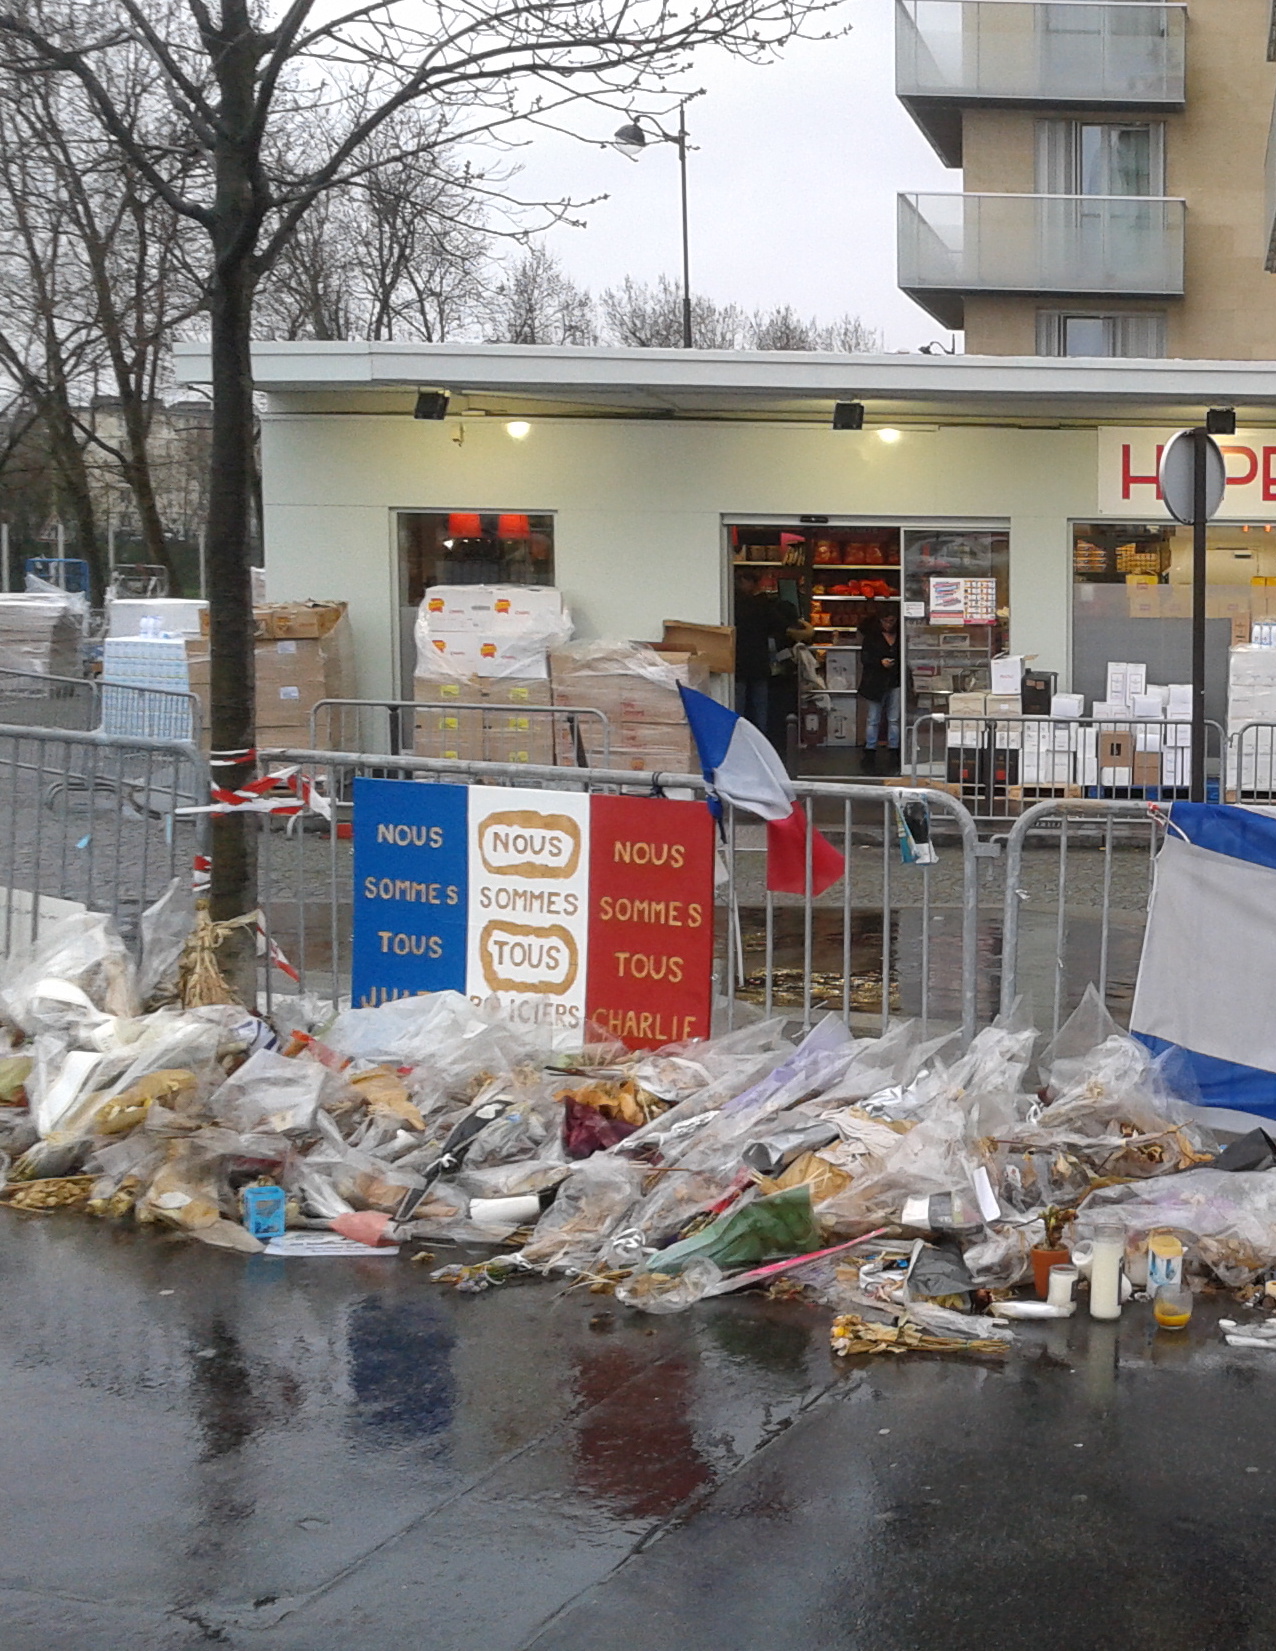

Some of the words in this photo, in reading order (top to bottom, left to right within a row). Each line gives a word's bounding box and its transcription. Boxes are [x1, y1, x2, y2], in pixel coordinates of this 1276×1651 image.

[377, 823, 443, 848] NOUS
[493, 831, 563, 857] NOUS
[614, 840, 685, 868] NOUS
[364, 876, 459, 905] SOMMES
[480, 886, 579, 916] SOMMES
[599, 896, 702, 928] SOMMES
[377, 931, 443, 958] TOUS
[493, 940, 561, 971] TOUS
[614, 951, 685, 983] TOUS
[470, 995, 580, 1029] POICIERS
[591, 1008, 697, 1040] CHARLIE
